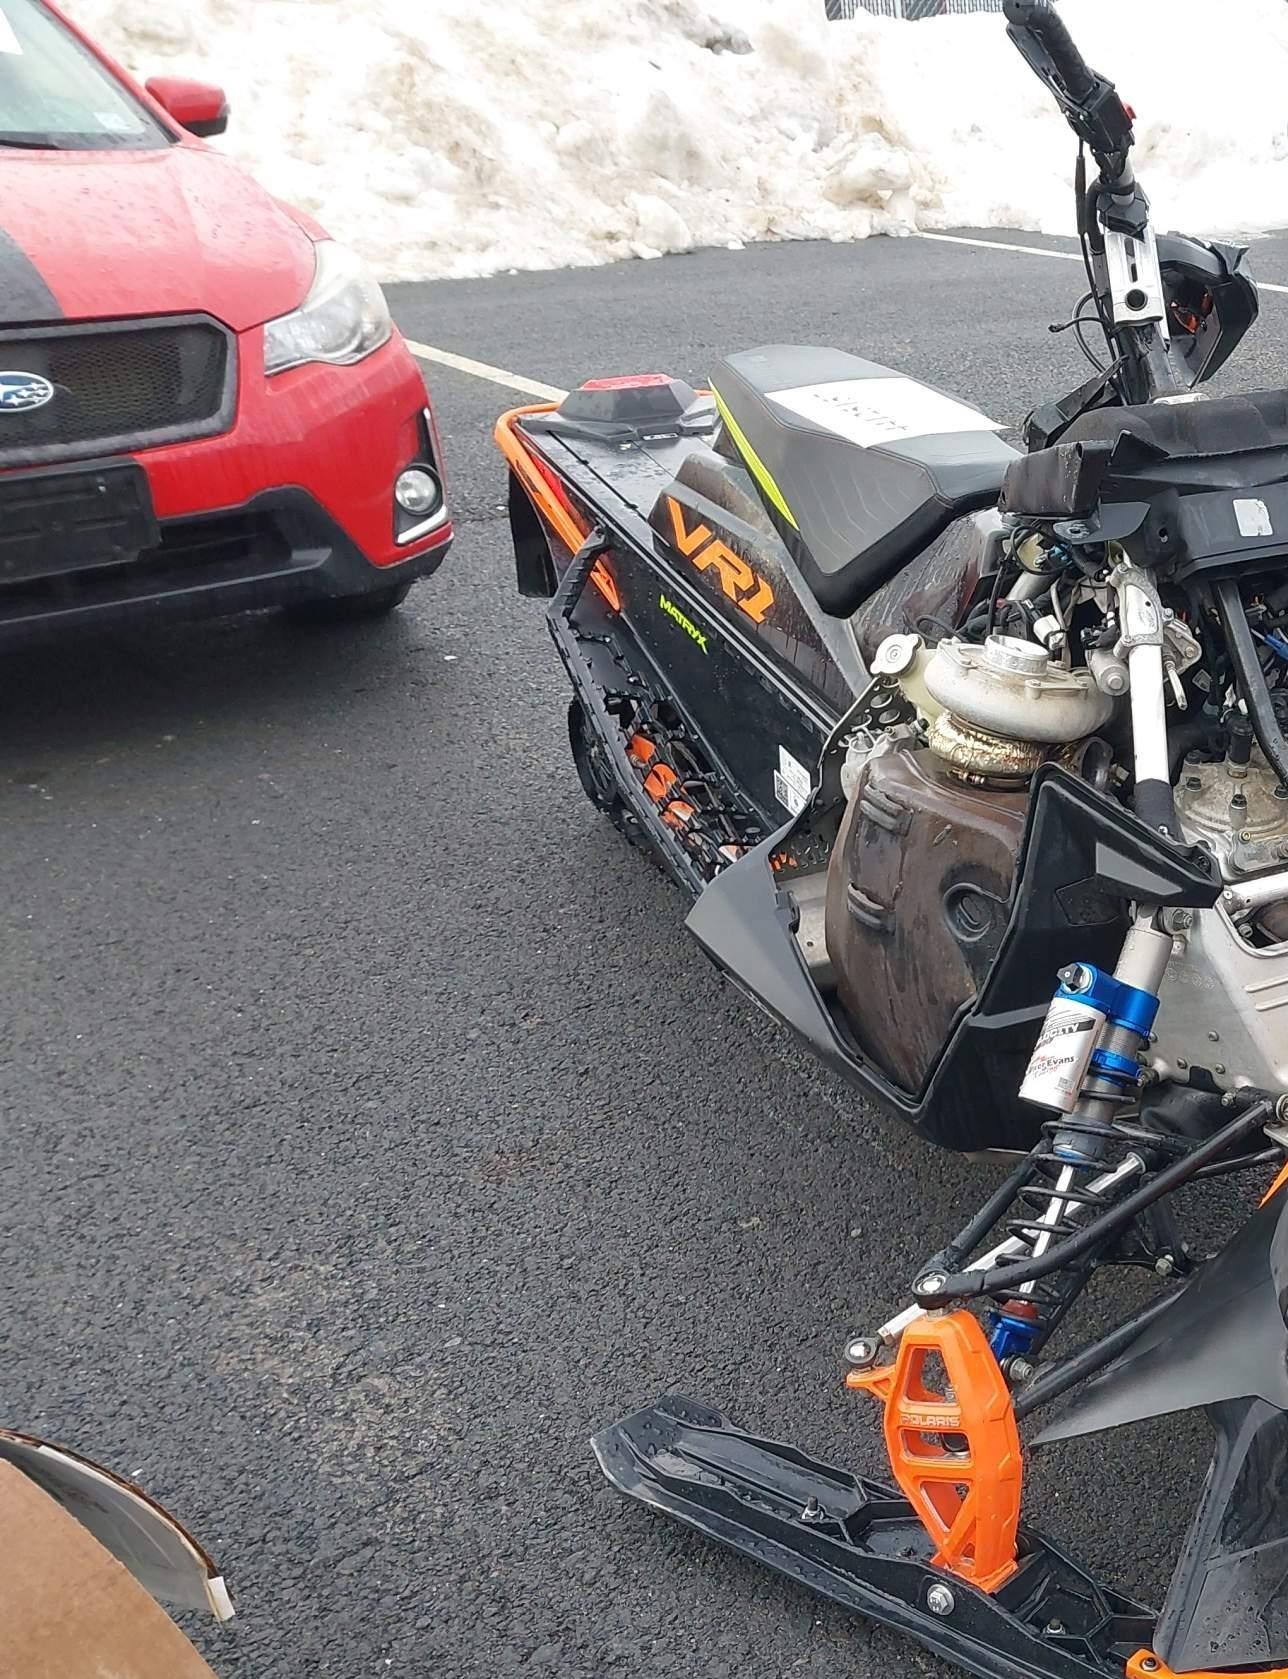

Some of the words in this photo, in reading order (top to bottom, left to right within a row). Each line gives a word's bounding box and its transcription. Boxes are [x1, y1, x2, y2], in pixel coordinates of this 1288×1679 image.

[667, 496, 774, 623] VR1
[659, 594, 709, 655] MATRYX
[1047, 1055, 1075, 1067] Evans
[901, 1414, 960, 1427] POLARIS
